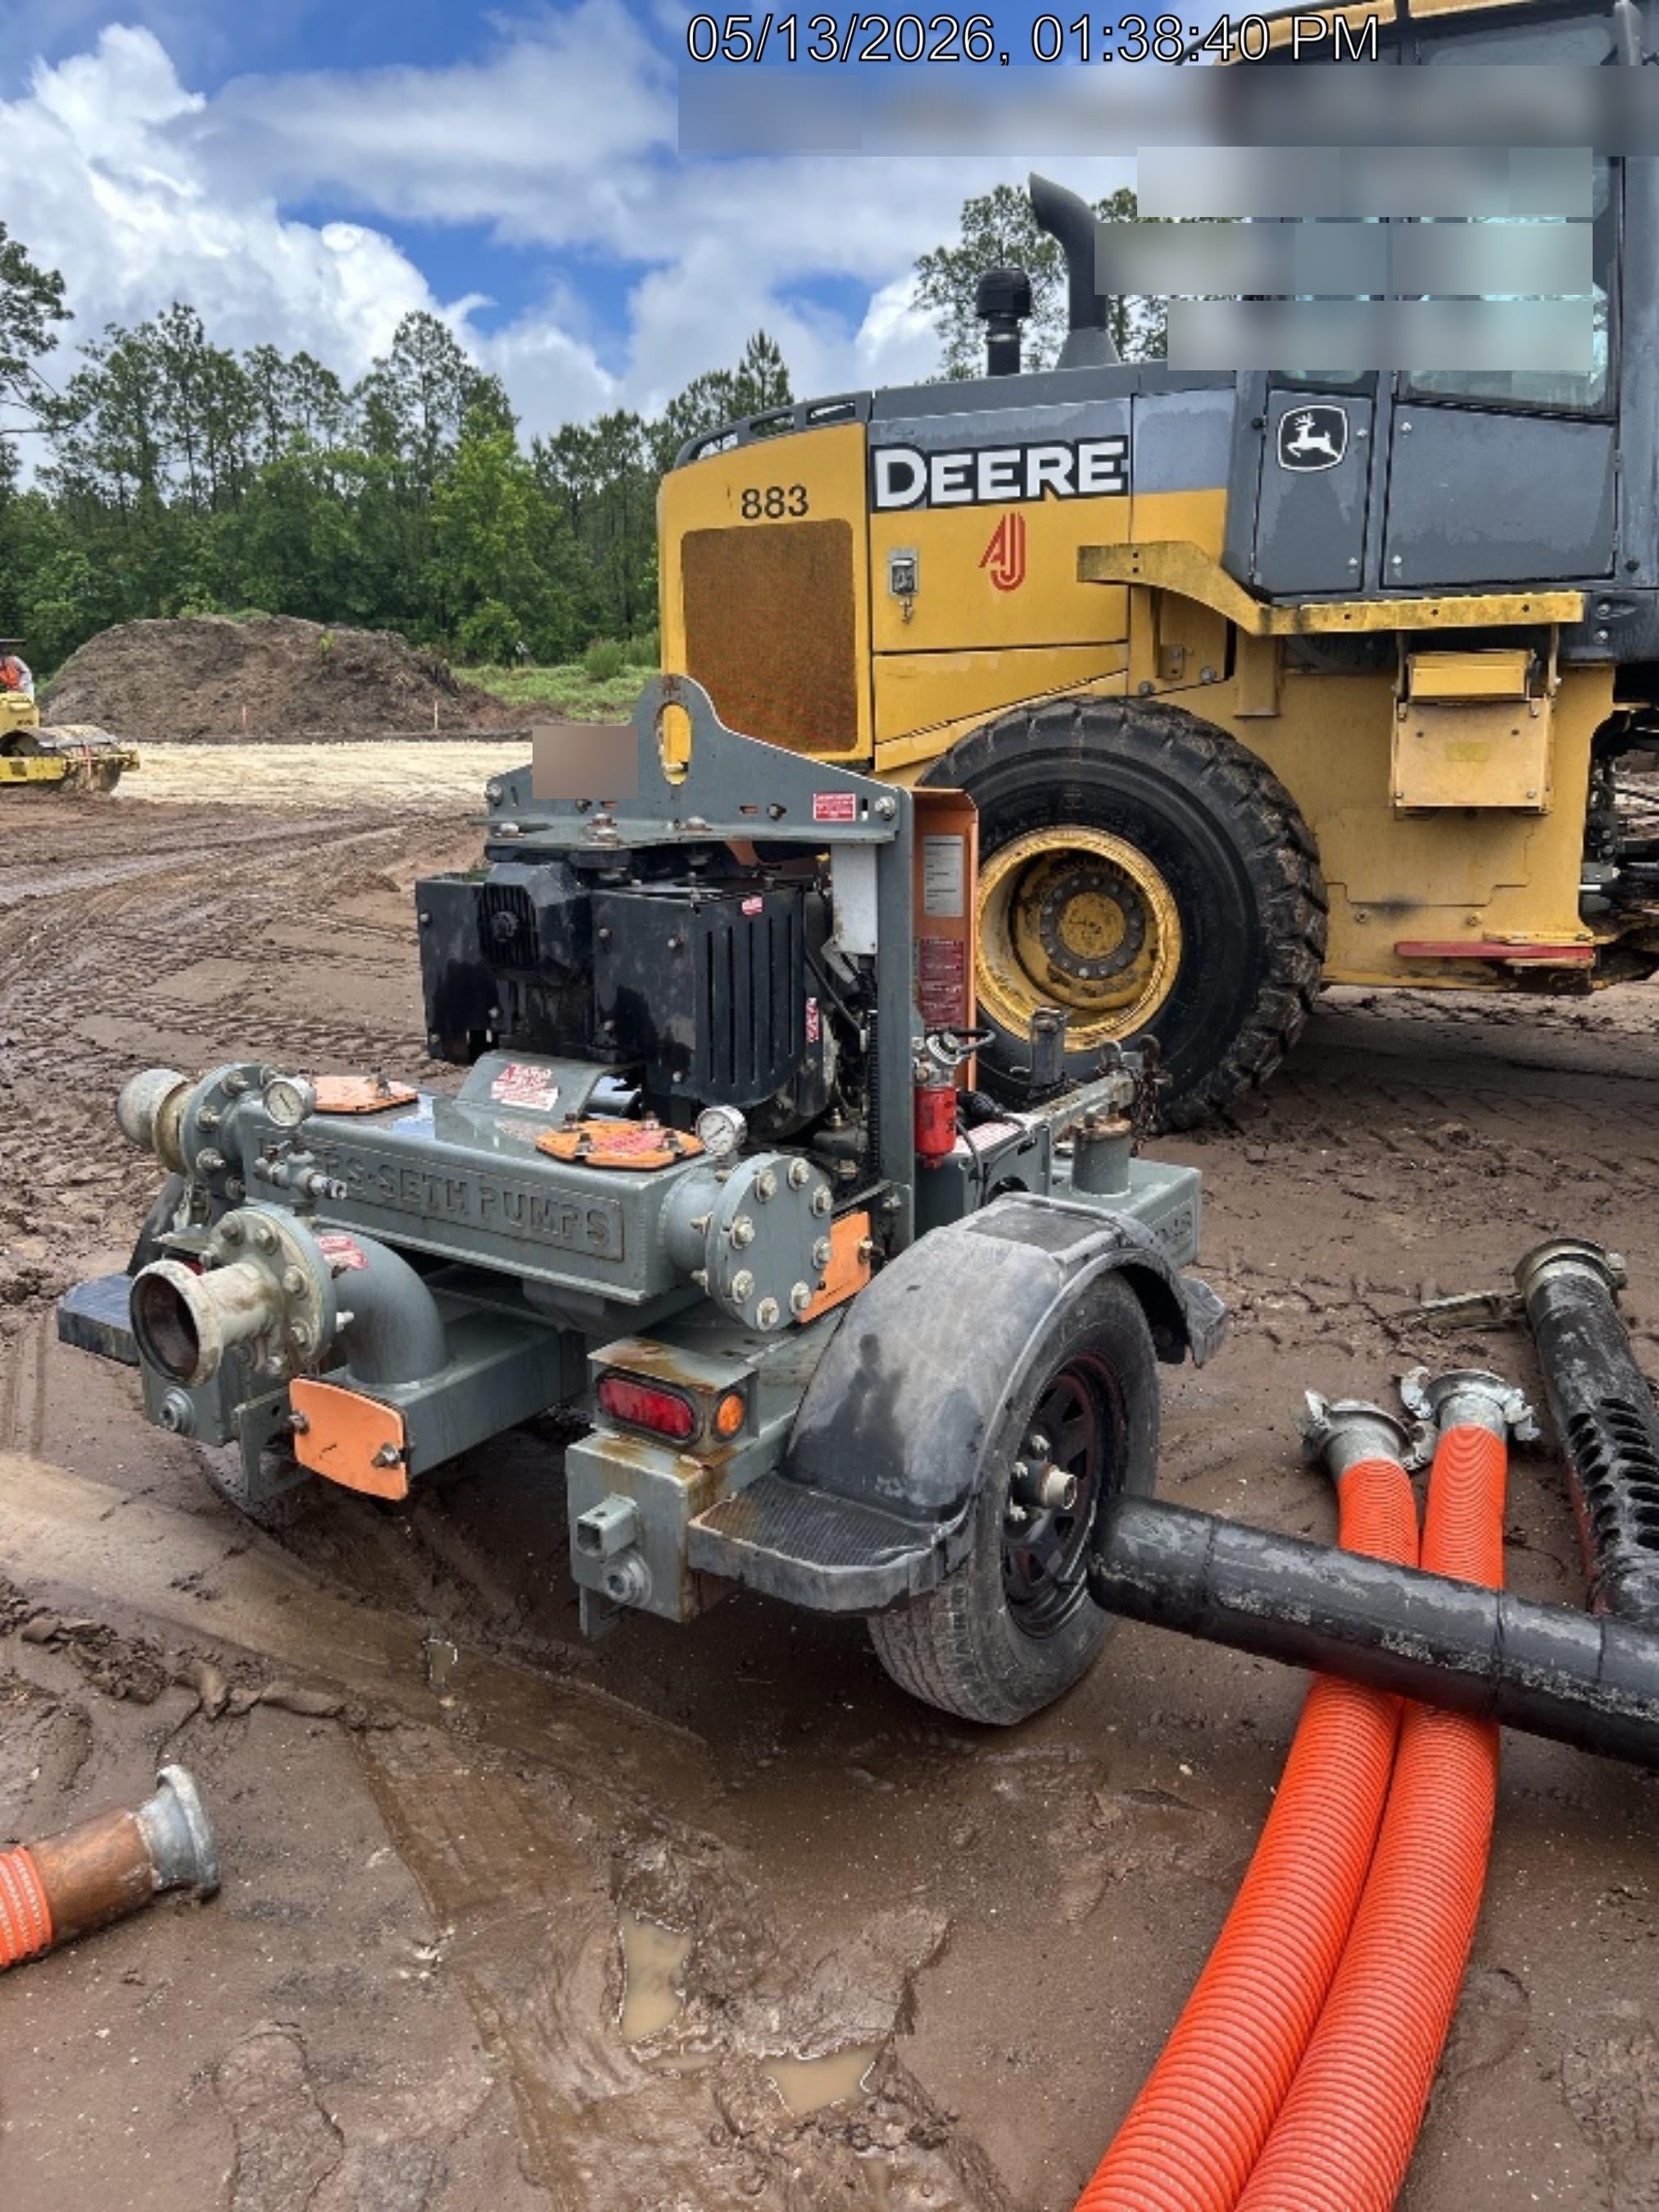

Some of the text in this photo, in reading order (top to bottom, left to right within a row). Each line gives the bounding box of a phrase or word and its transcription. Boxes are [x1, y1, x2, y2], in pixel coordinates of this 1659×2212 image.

[741, 484, 809, 519] 883
[873, 440, 1125, 509] DEERE
[479, 1186, 610, 1249] PUMPS
